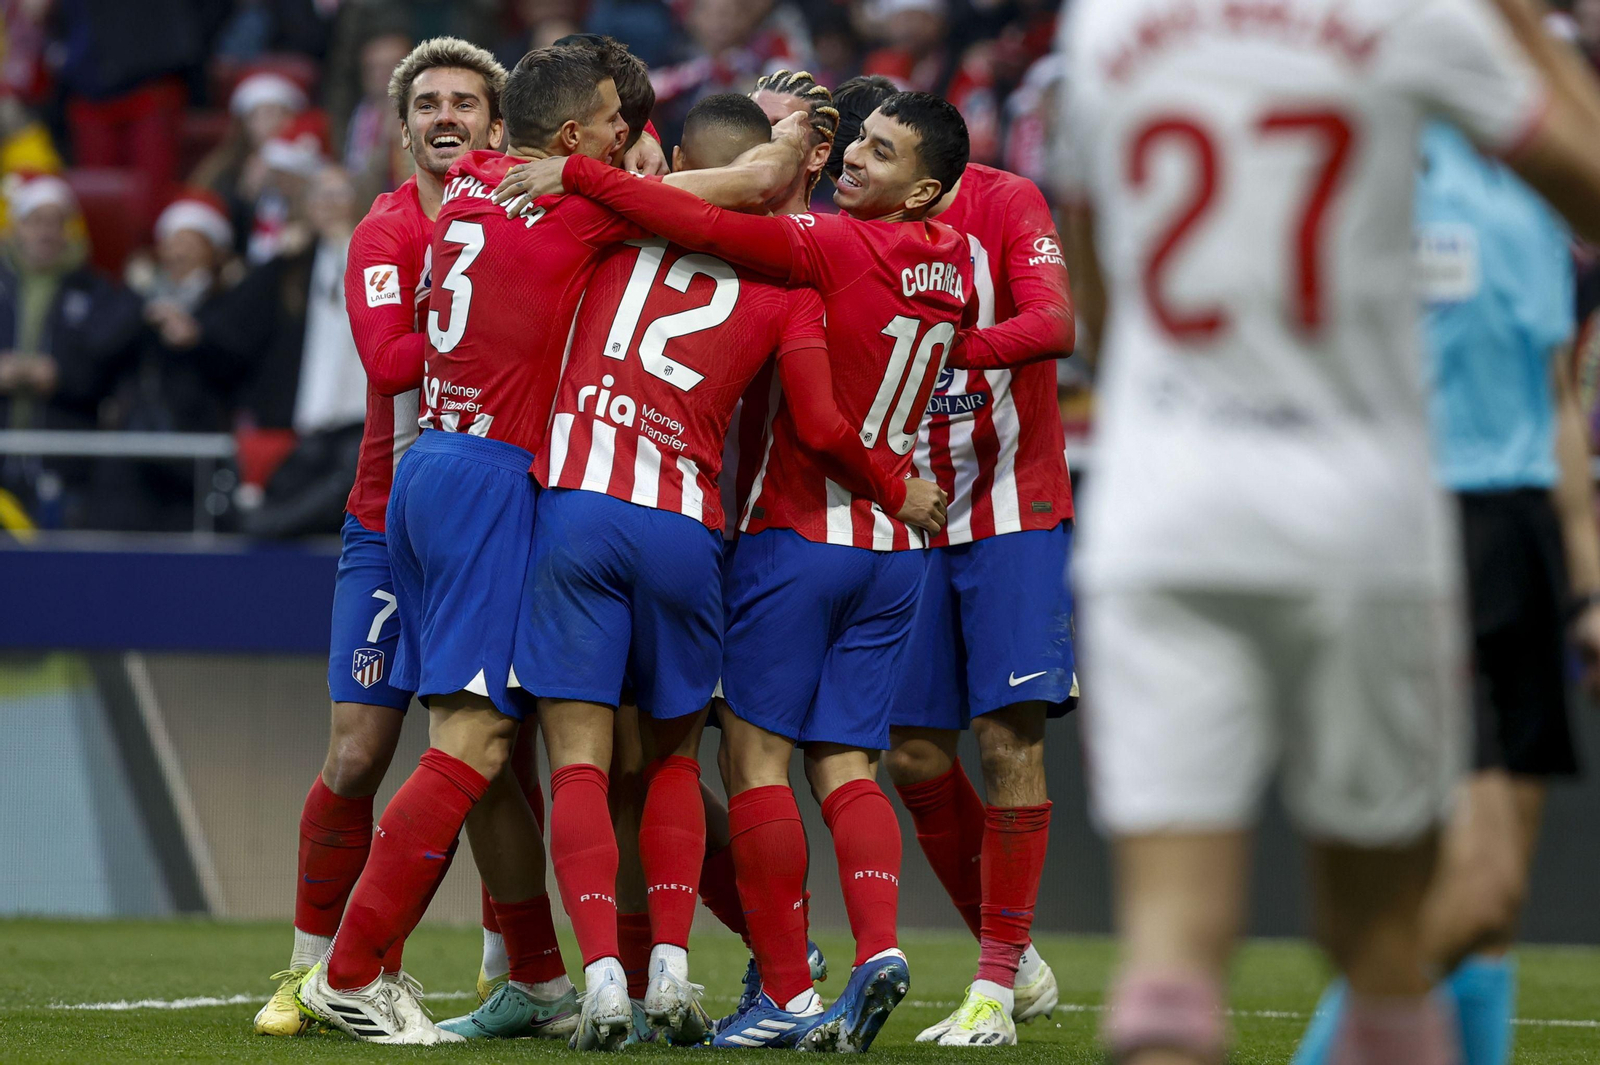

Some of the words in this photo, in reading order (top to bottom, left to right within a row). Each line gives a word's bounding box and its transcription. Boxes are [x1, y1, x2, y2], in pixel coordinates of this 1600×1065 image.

[1124, 110, 1355, 345] 27
[370, 292, 397, 303] LALIGA
[427, 220, 486, 354] 3
[901, 261, 966, 305] CORREA
[602, 236, 741, 393] 12
[441, 380, 482, 400] Money
[577, 374, 637, 428] ria
[858, 314, 956, 456] 10
[954, 394, 985, 412] AIR
[640, 418, 689, 452] Transfer
[641, 403, 685, 436] Money
[366, 589, 398, 644] 7
[647, 883, 694, 895] ATLETI
[854, 870, 899, 887] ATLETI
